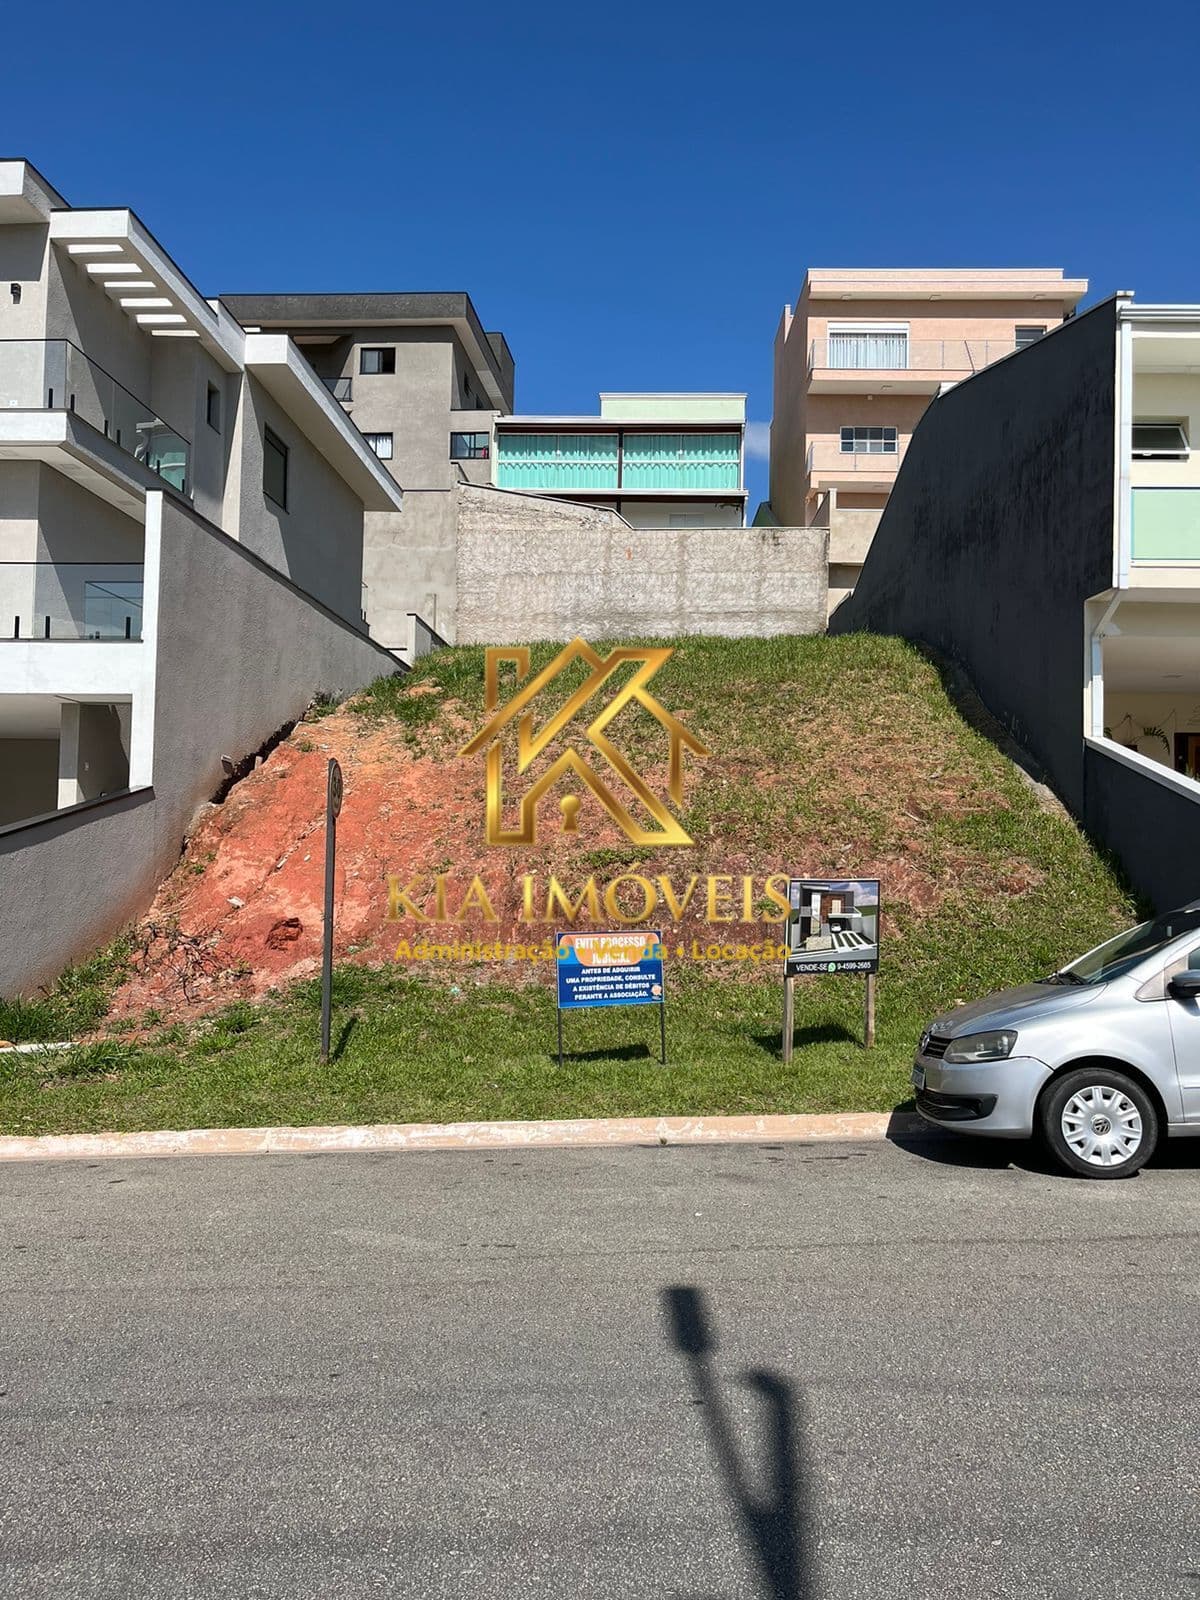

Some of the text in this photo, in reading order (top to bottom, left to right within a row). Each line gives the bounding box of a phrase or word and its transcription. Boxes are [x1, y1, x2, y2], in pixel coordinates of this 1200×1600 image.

[581, 967, 602, 975] ANTES
[795, 963, 828, 972] VENDE-SE
[578, 984, 614, 992] EXISTÊNCIA
[609, 990, 648, 999] ASSOCIAÇÃO.
